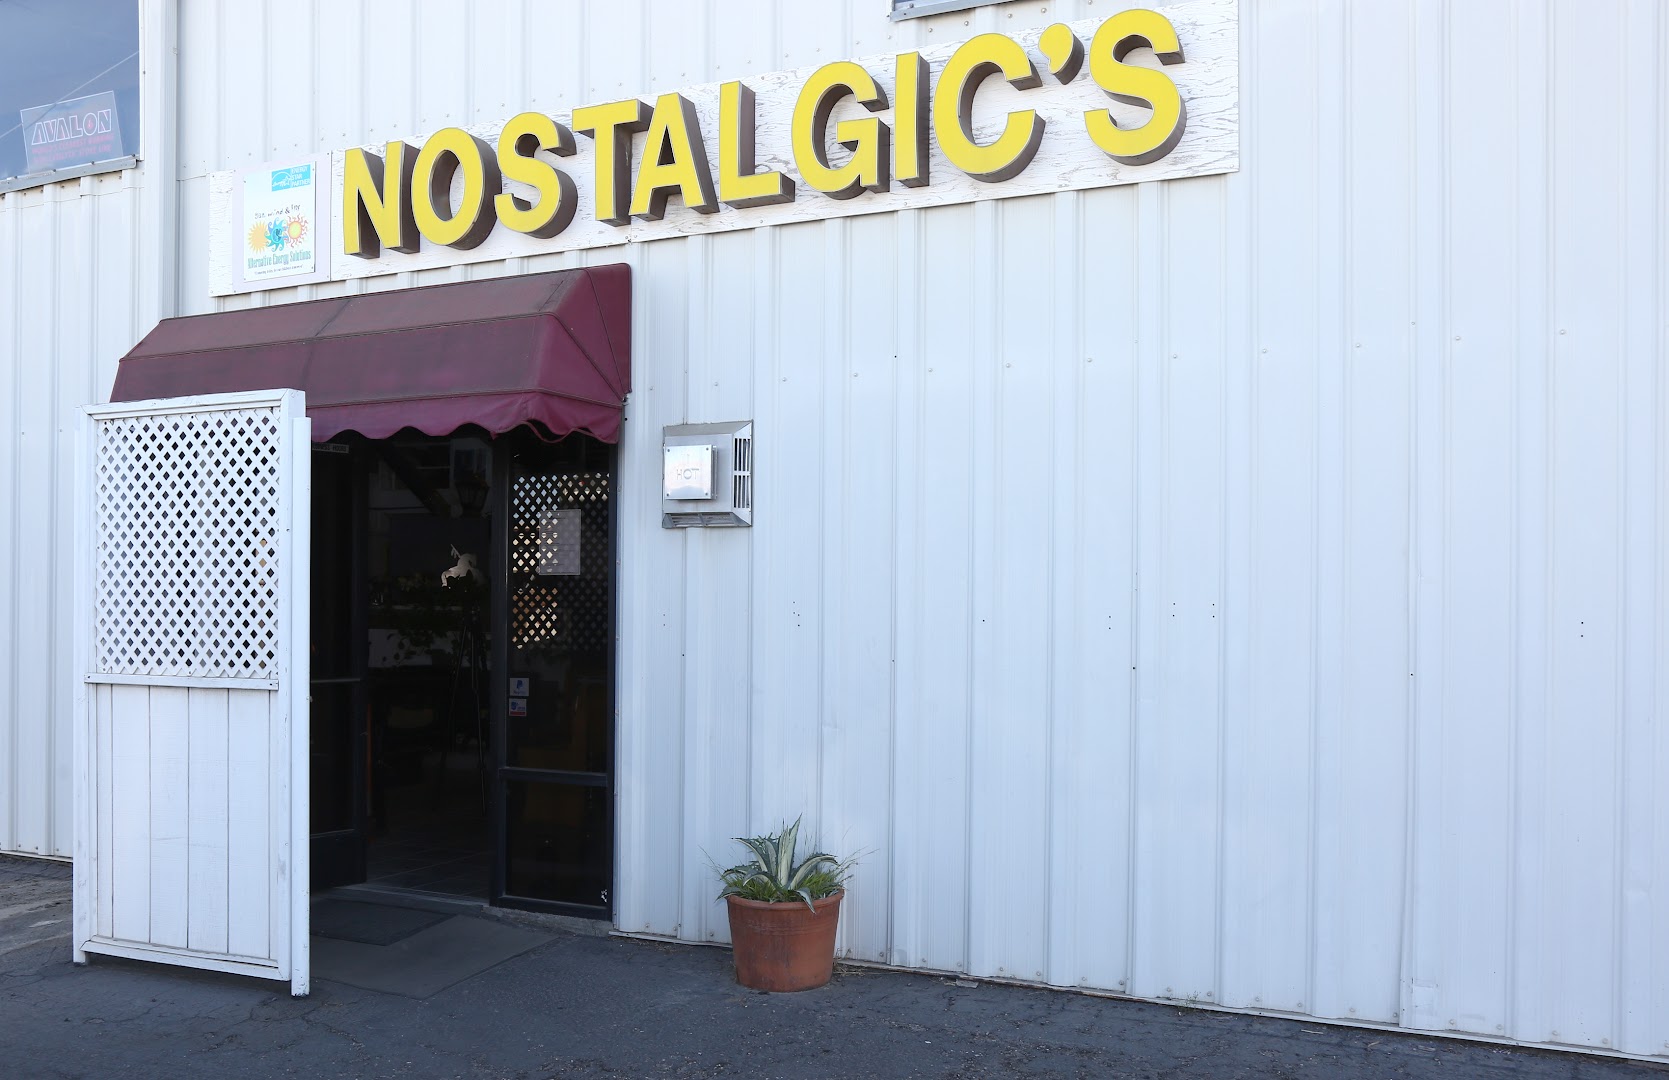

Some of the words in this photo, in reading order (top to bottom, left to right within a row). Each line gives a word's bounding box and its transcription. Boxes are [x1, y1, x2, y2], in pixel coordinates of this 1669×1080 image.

[31, 109, 112, 145] AVALON
[343, 9, 1185, 258] NOSTALGIC'S
[676, 468, 700, 480] HOT
